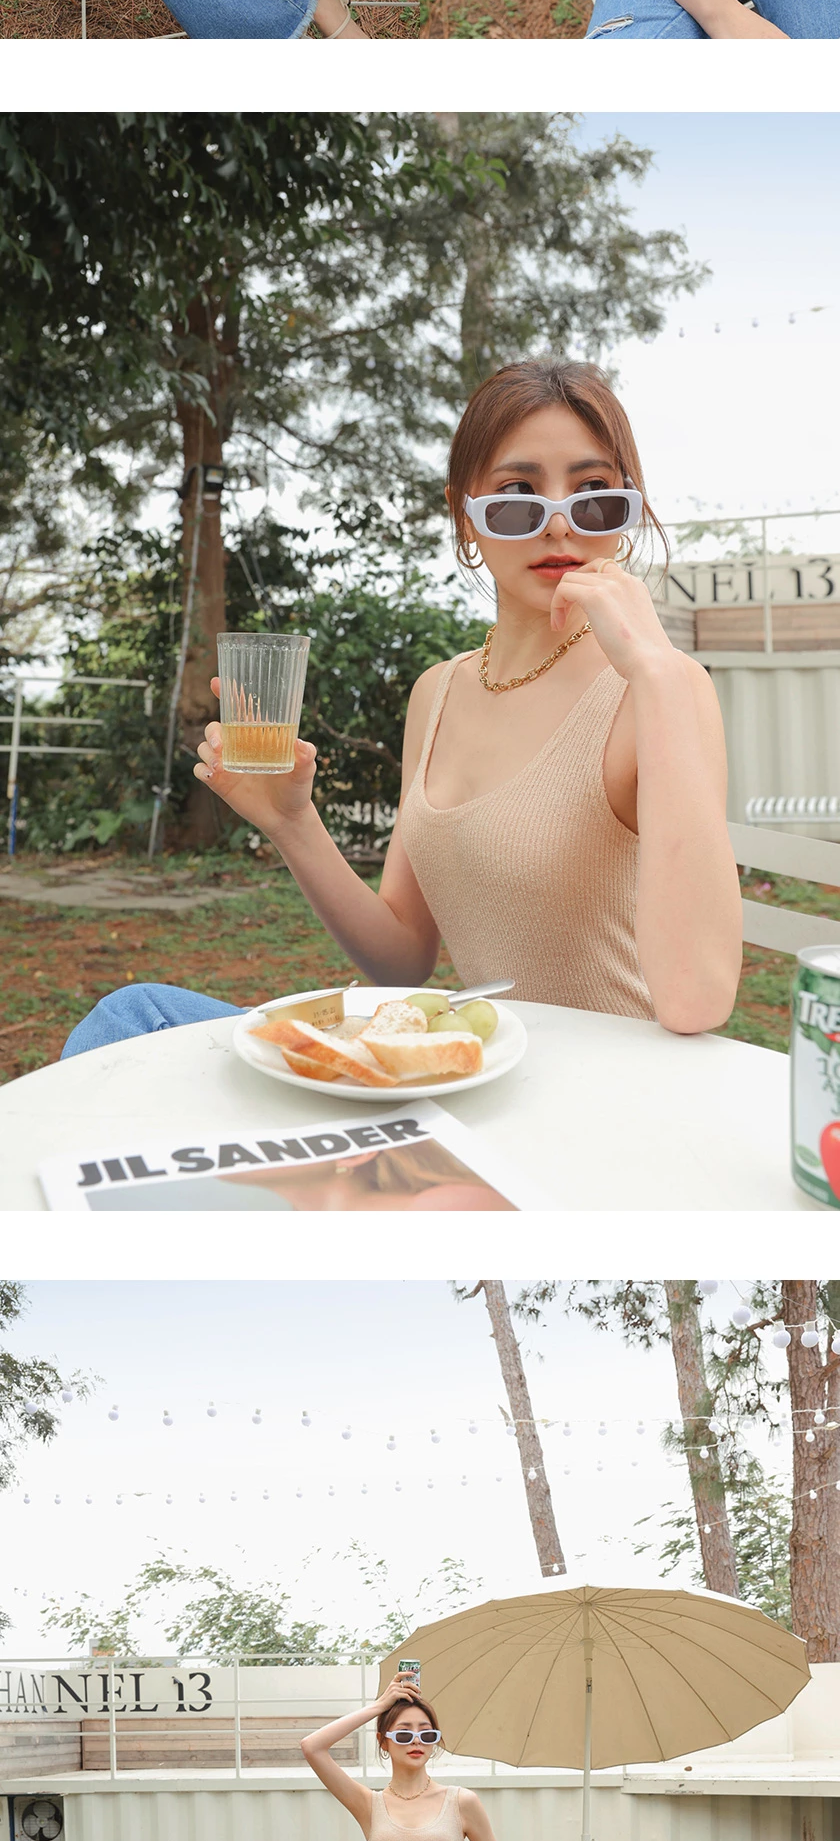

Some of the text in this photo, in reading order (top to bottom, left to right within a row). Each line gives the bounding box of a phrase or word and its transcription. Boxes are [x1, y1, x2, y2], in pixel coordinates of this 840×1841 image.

[790, 558, 835, 600] 13
[77, 1118, 431, 1187] JIL SANDER
[171, 1672, 213, 1713] 13
